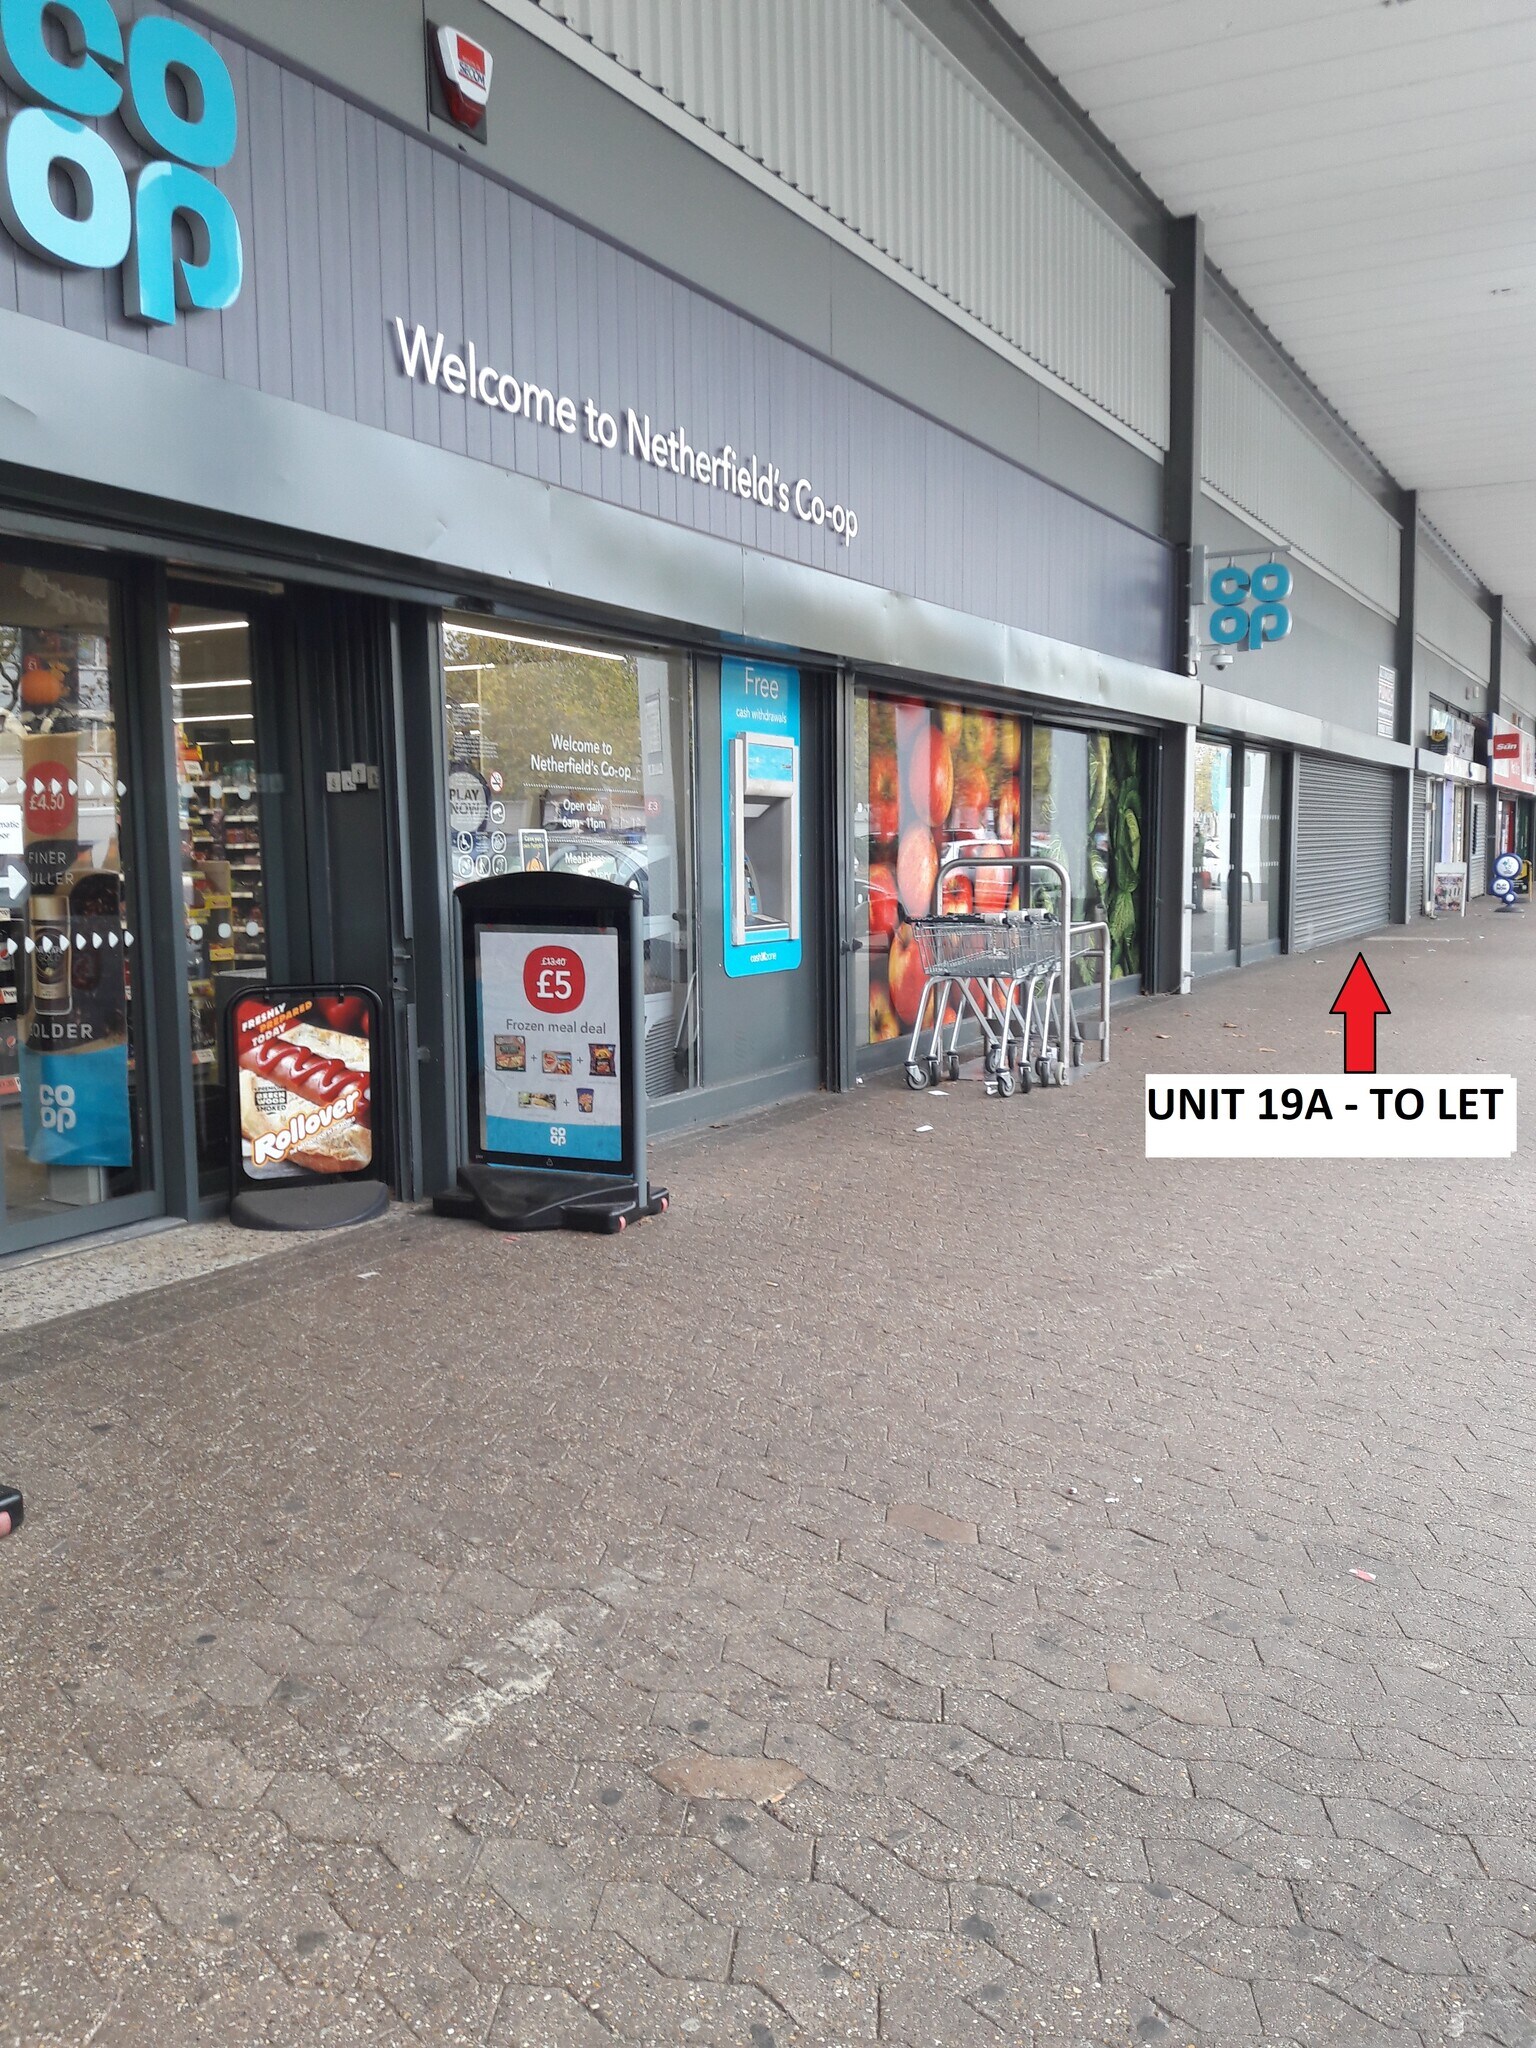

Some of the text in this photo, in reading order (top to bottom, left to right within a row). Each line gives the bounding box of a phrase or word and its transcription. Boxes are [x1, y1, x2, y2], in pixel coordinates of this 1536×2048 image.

[395, 316, 858, 547] Welcome to Netherfield's Co-op
[745, 666, 779, 699] Free
[736, 706, 787, 724] cash withdrawals
[551, 733, 613, 756] Welcome to
[530, 754, 632, 782] Netherfield's Co-op
[29, 793, 65, 811] £4.50
[450, 788, 480, 801] PLAY
[563, 799, 604, 815] Open daily
[28, 851, 67, 865] FINER
[29, 872, 74, 886] ULLER
[536, 969, 572, 1000] £5
[241, 1002, 287, 1032] FRESHLY
[259, 1000, 313, 1033] PREPARED
[29, 1023, 94, 1039] OLDER
[251, 1022, 287, 1047] TODAY
[506, 1019, 606, 1035] Frozen meal deal
[257, 1104, 287, 1113] SMOKED
[254, 1089, 361, 1165] Rollover
